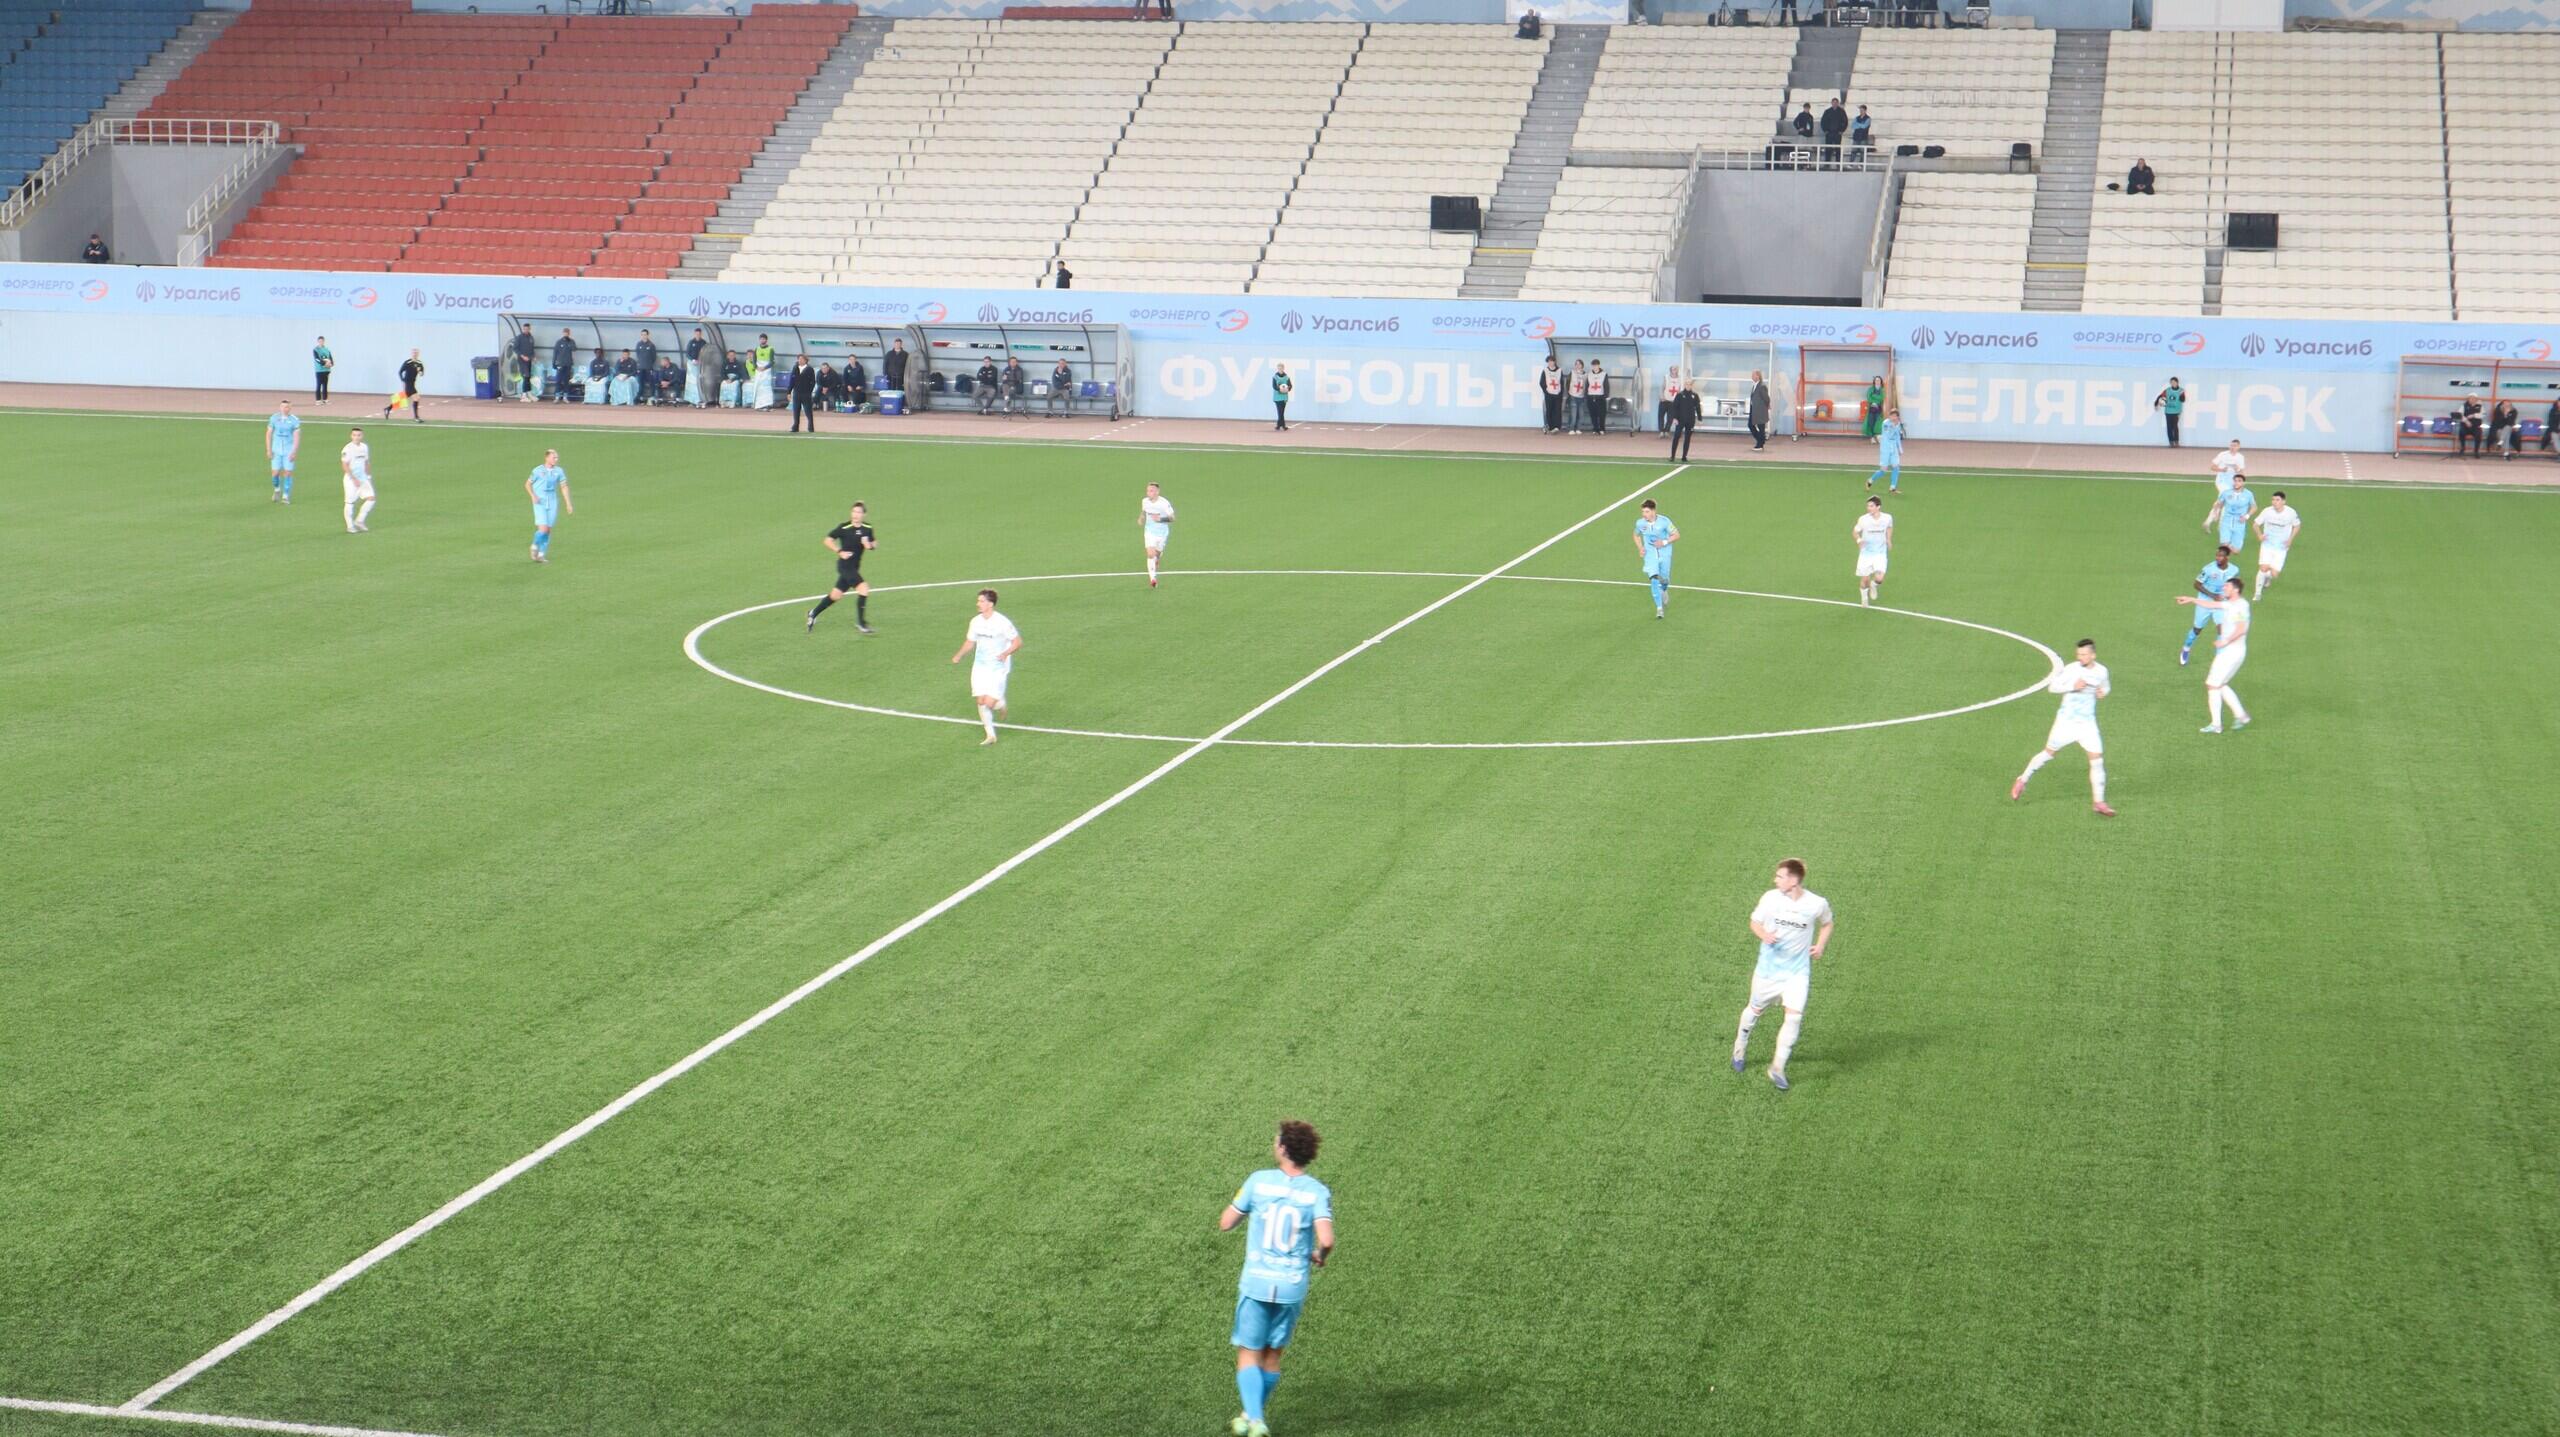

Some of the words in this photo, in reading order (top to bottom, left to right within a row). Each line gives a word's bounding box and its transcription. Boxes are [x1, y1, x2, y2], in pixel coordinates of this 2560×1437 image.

[3, 279, 75, 290] ФОРЭНЕРГО
[163, 285, 241, 301] Уралсиб
[270, 287, 342, 298] ФОРЭНЕРГО
[434, 293, 514, 309] Уралсиб
[548, 294, 623, 306] ФОРЭНЕРГО
[718, 301, 801, 318] Уралсиб
[831, 302, 909, 313] ФОРЭНЕРГО
[1008, 308, 1094, 323] Уралсиб
[1129, 309, 1210, 321] ФОРЭНЕРГО
[1312, 315, 1400, 333] Уралсиб
[1432, 316, 1515, 328] ФОРЭНЕРГО
[1621, 323, 1712, 340] Уралсиб
[1750, 324, 1836, 336] ФОРЭНЕРГО
[1944, 331, 2038, 348] Уралсиб
[2073, 332, 2162, 344] ФОРЭНЕРГО
[2275, 338, 2372, 357] Уралсиб
[2414, 339, 2507, 351] ФОРЭНЕРГО
[1261, 1203, 1300, 1252] 10
